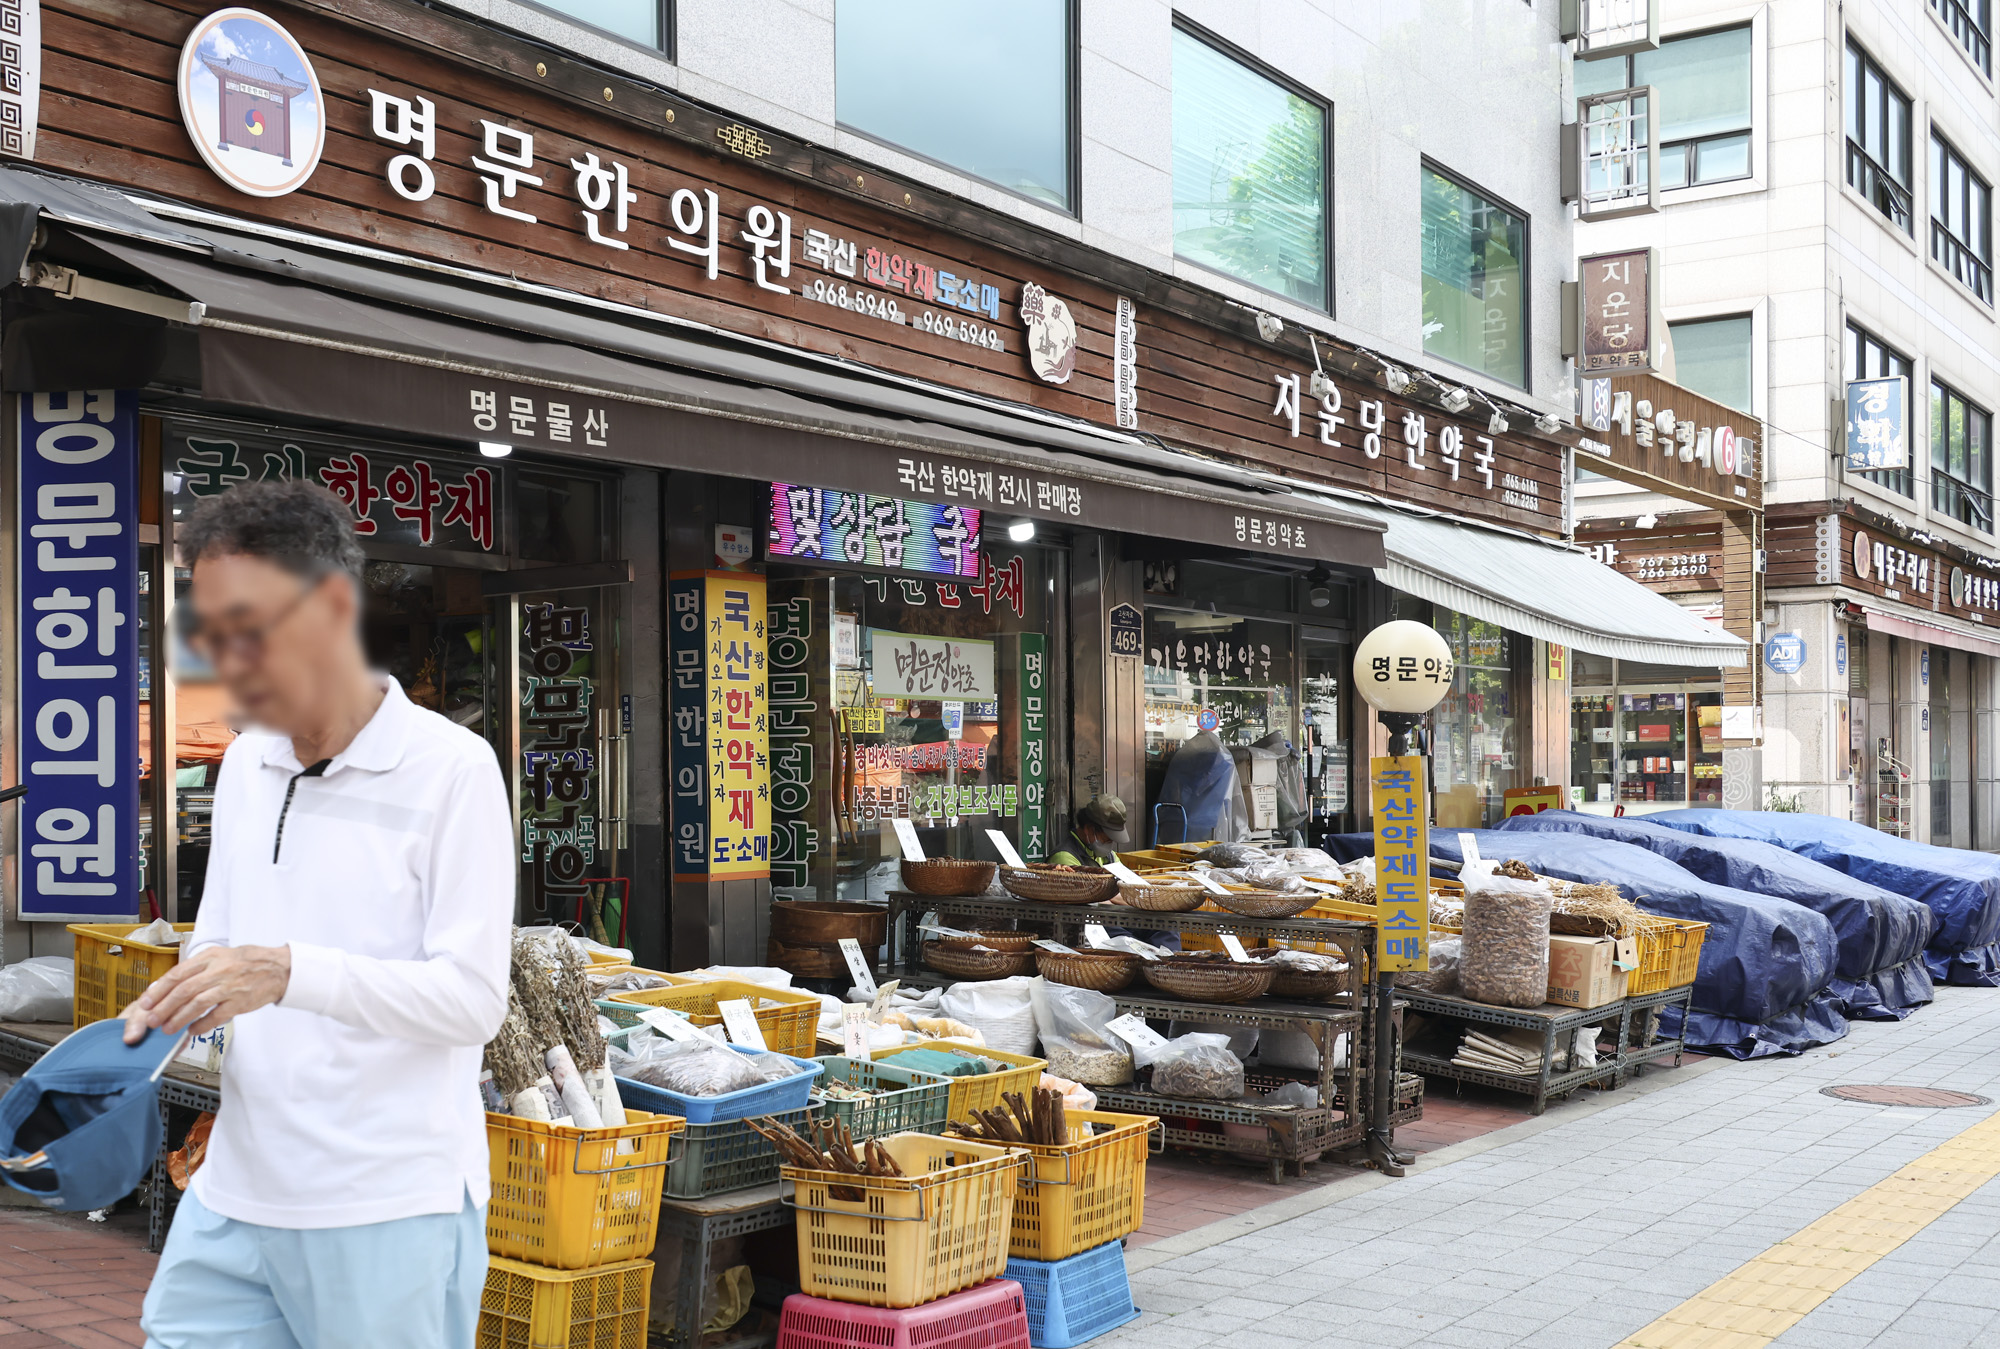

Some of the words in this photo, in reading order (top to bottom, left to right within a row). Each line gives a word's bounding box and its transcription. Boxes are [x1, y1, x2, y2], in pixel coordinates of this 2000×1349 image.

[366, 88, 791, 295] 명문한의원
[805, 228, 857, 278] 국산
[813, 280, 848, 309] 968
[855, 290, 898, 322] 5949
[923, 311, 954, 337] 969
[958, 319, 998, 350] 5949
[1601, 260, 1633, 348] 지운당
[1591, 353, 1639, 369] 한약국
[470, 389, 609, 447] 명문물산
[897, 459, 935, 494] 국산
[941, 465, 993, 502] 한약재
[998, 473, 1032, 509] 전시
[1036, 481, 1082, 516] 판매장
[1504, 473, 1518, 490] 965
[1504, 490, 1518, 506] 957
[1521, 494, 1538, 510] 2253
[788, 488, 823, 555] 및
[932, 505, 979, 576] 국
[1234, 513, 1307, 549] 명문정약초
[1638, 556, 1664, 568] 967
[1671, 553, 1707, 566] 3348
[1638, 567, 1665, 579] 966
[1671, 564, 1707, 577] 6590
[1115, 630, 1137, 652] 469
[1770, 645, 1801, 661] ADT
[673, 589, 704, 864] 명문한의원
[767, 598, 818, 901] 명문정약
[1024, 652, 1045, 859] 명문정약초
[926, 783, 1018, 818] 건강보조식품
[1378, 769, 1421, 961] 국산약재도소매
